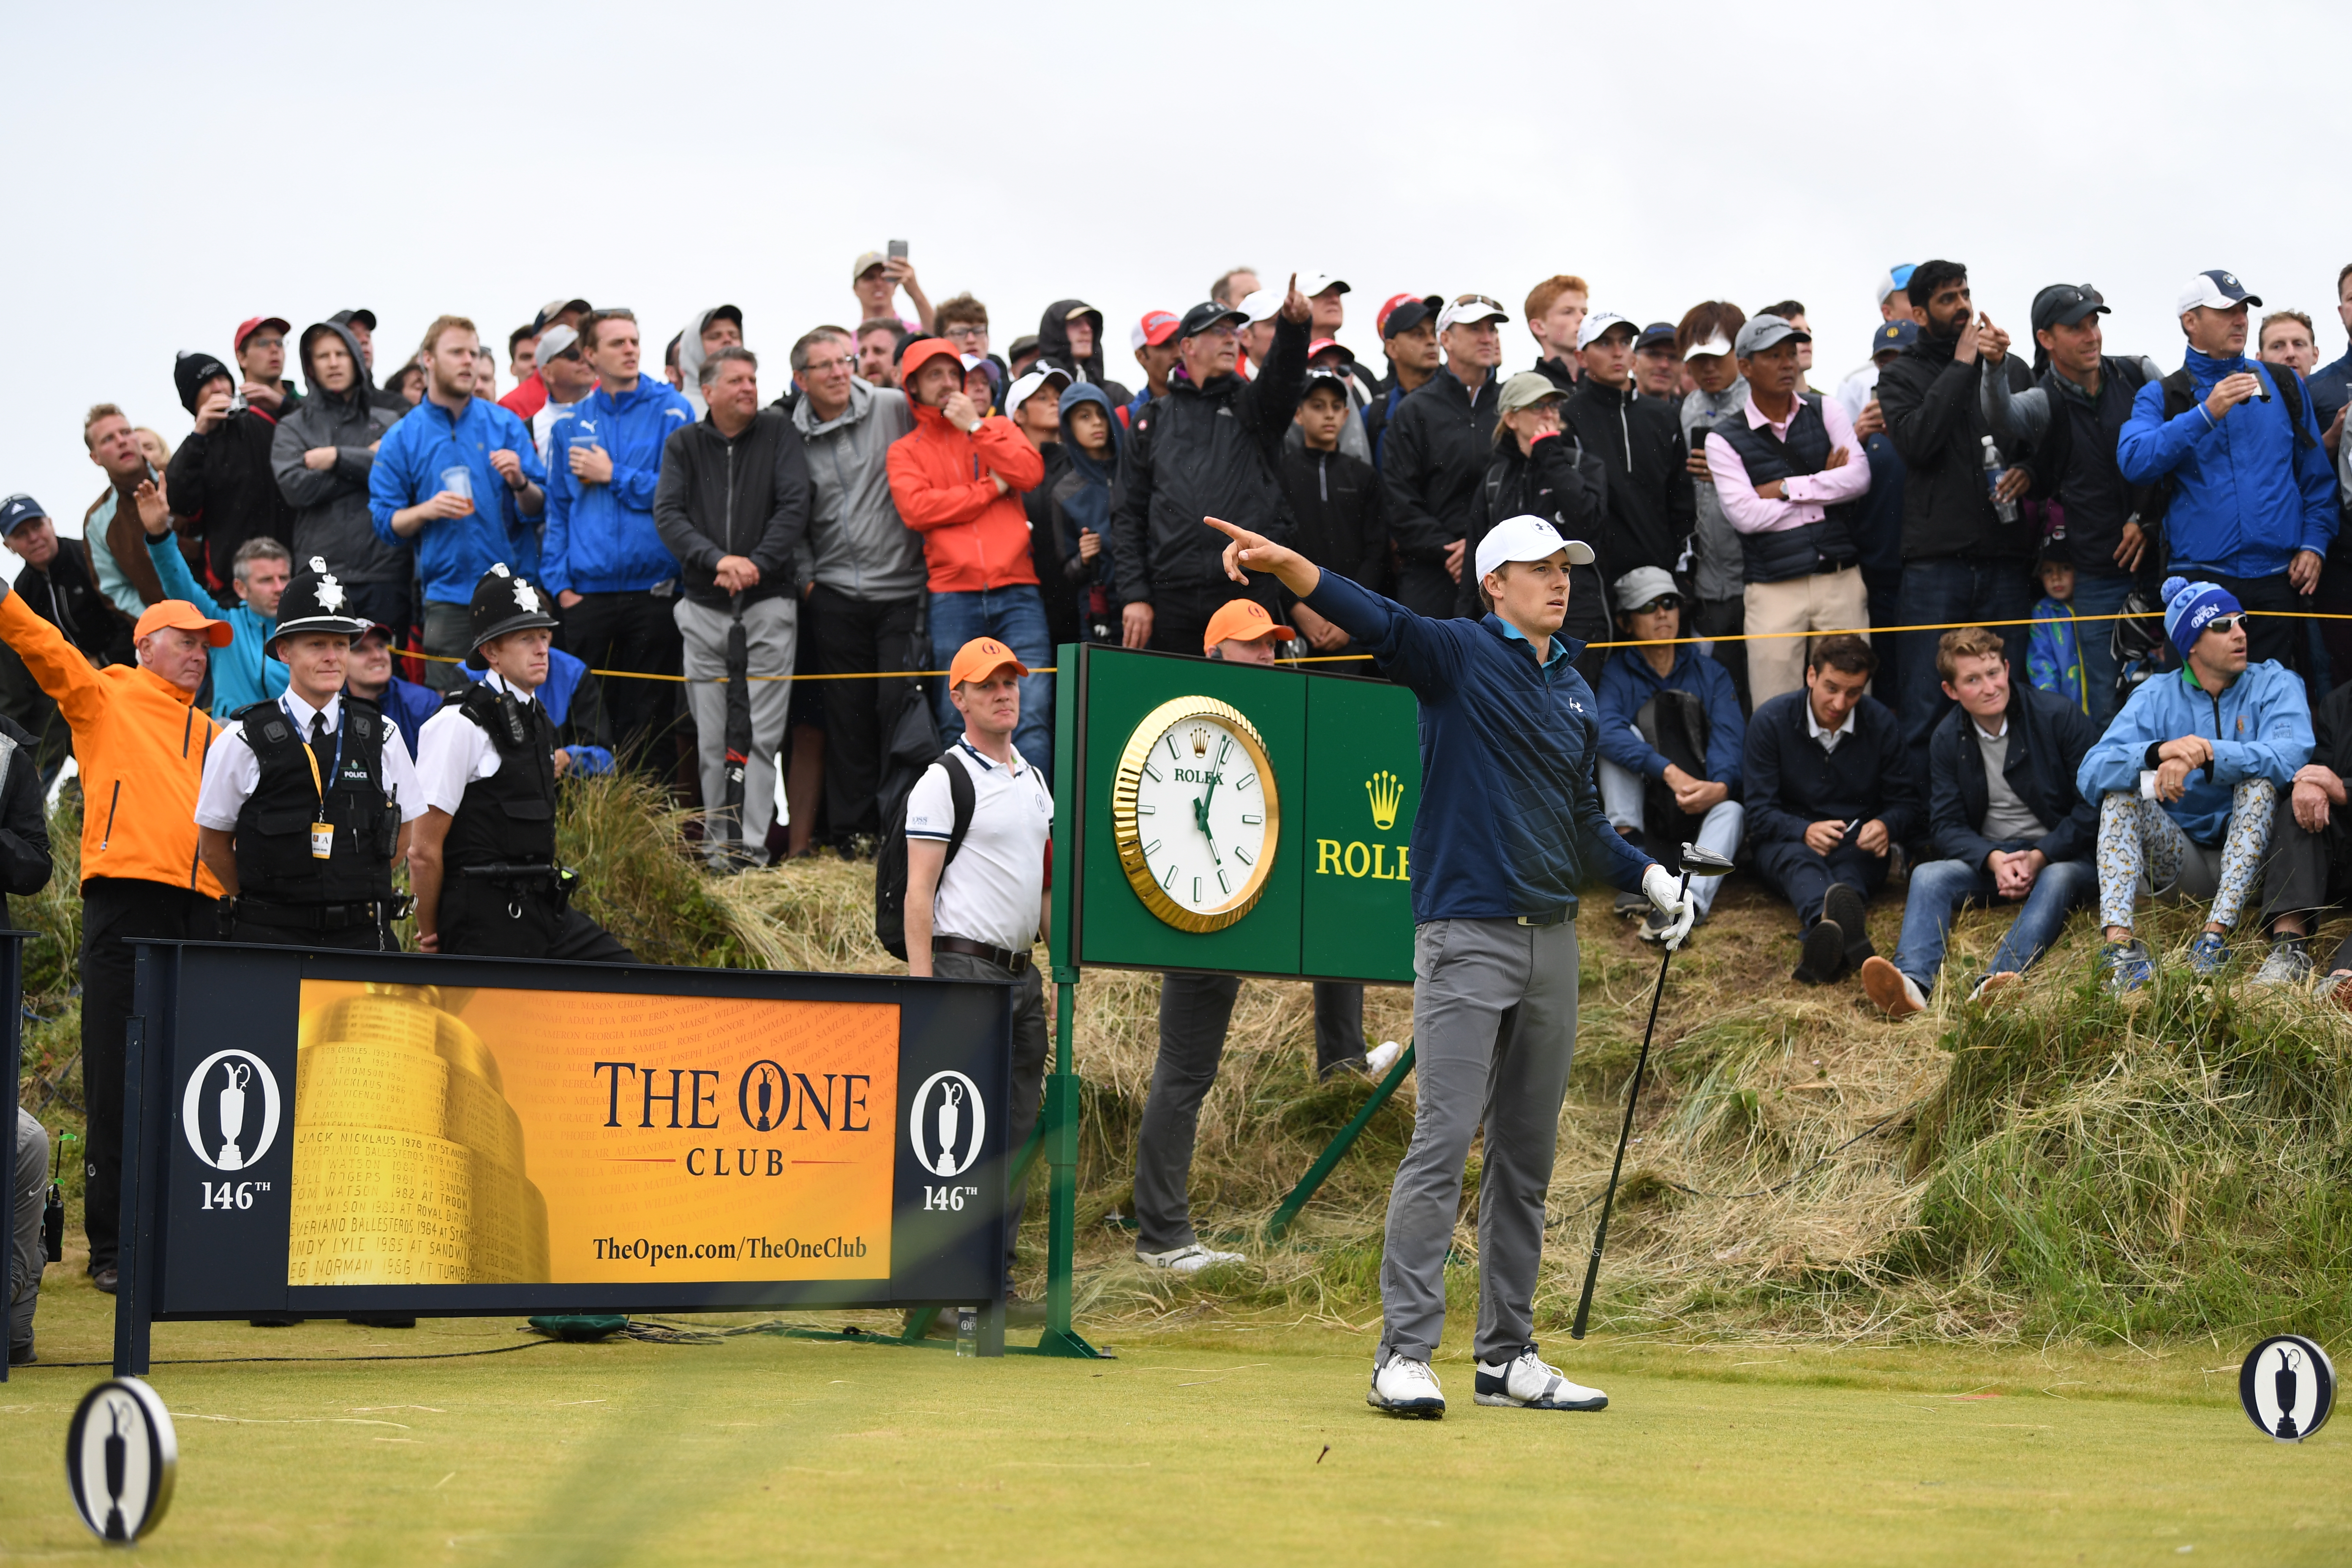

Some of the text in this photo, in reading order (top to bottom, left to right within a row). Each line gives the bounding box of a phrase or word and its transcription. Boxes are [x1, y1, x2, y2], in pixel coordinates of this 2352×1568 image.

[2191, 603, 2220, 629] OPEN
[2194, 604, 2207, 615] THE
[1174, 768, 1224, 785] ROLEX
[1316, 838, 1410, 881] ROLE
[557, 1000, 576, 1009] EVIE
[581, 1001, 613, 1010] MASON
[618, 999, 647, 1009] CHLOE
[567, 1016, 594, 1024] ADAM
[599, 1016, 615, 1025] EVA
[621, 1014, 643, 1024] RORY
[648, 1010, 669, 1021] ERIN
[673, 1000, 710, 1016] NATHAN
[535, 999, 753, 1040] CAMERON GEORGIA HARRISON MAISIE WILLIAM
[535, 1002, 777, 1056] LIAM AMBER OLLIE SAMUEL ROSIE CONNOR JAMIE
[373, 1049, 390, 1057] 1963
[535, 1060, 561, 1071] THEO
[566, 1063, 592, 1072] ALICE
[642, 1056, 665, 1069] LILLY
[670, 1049, 702, 1065] JOSEPH
[707, 1039, 730, 1054] LEAH
[735, 1013, 792, 1045] MUHAMMAD
[373, 1058, 389, 1067] 1964
[559, 1113, 594, 1123] GRACIE
[803, 1045, 830, 1068] AIDEN
[834, 1028, 857, 1049] ROSE
[861, 1005, 891, 1031] BLAKE
[562, 1079, 603, 1088] REBECCA
[705, 1055, 734, 1070] DAVID
[739, 1044, 762, 1062] JOHN
[770, 1021, 811, 1047] ISABELLA
[574, 1095, 612, 1105] MICHAE
[784, 1038, 810, 1058] ABBIE
[816, 1013, 853, 1041] SAMUEL
[339, 1067, 384, 1078] THOMSON
[560, 1131, 597, 1141] PHOEBE
[602, 1128, 632, 1140] OWEN
[826, 1050, 853, 1073] PAIGE
[857, 1024, 891, 1054] FRASER
[343, 1089, 381, 1101] VICENZO
[387, 1083, 406, 1094] 1966
[594, 1059, 870, 1132] THE ONE
[299, 1132, 333, 1143] JACK
[341, 1132, 396, 1145] NICKLAUS
[402, 1138, 422, 1149] 1978
[427, 1143, 437, 1152] AT
[581, 1149, 609, 1158] BLAIR
[615, 1141, 674, 1157] ALEXANDRA
[679, 1131, 714, 1147] CALVIN
[297, 1146, 359, 1157] SEVERIANO
[427, 1154, 443, 1165] 1979
[686, 1148, 783, 1176] CLUB
[294, 1160, 320, 1171] TOM
[329, 1159, 381, 1169] WATSON
[423, 1165, 434, 1176] AT
[574, 1167, 604, 1177] BELLA
[610, 1162, 650, 1176] ARTHUR
[292, 1174, 320, 1186] BILL
[329, 1172, 381, 1182] ROGERS
[392, 1174, 414, 1185] 1981
[591, 1182, 638, 1196] LACHLAN
[644, 1174, 688, 1191] MATILDA
[201, 1181, 271, 1210] 146TH
[292, 1187, 317, 1200] TOM
[325, 1185, 379, 1197] WATSON
[392, 1187, 415, 1200] 1982
[422, 1190, 434, 1202] AT
[645, 1193, 689, 1209] WILLIAM
[923, 1185, 977, 1212] 146TH
[316, 1201, 366, 1216] WATSON
[372, 1201, 395, 1213] 1983
[400, 1203, 412, 1215] AT
[417, 1204, 442, 1220] ROYAL
[351, 1217, 414, 1234] BALLESTEROS
[417, 1221, 437, 1236] 1984
[439, 1227, 447, 1239] AT
[332, 1237, 365, 1253] LYLE
[376, 1237, 404, 1252] 1985
[410, 1240, 422, 1253] AT
[430, 1241, 480, 1263] SANDWICH
[486, 1252, 499, 1268] 282
[593, 1236, 867, 1267] TheOpen.com/TheOneClub
[315, 1258, 372, 1276] NORMAN
[383, 1258, 411, 1275] 1986
[419, 1260, 432, 1277] AT
